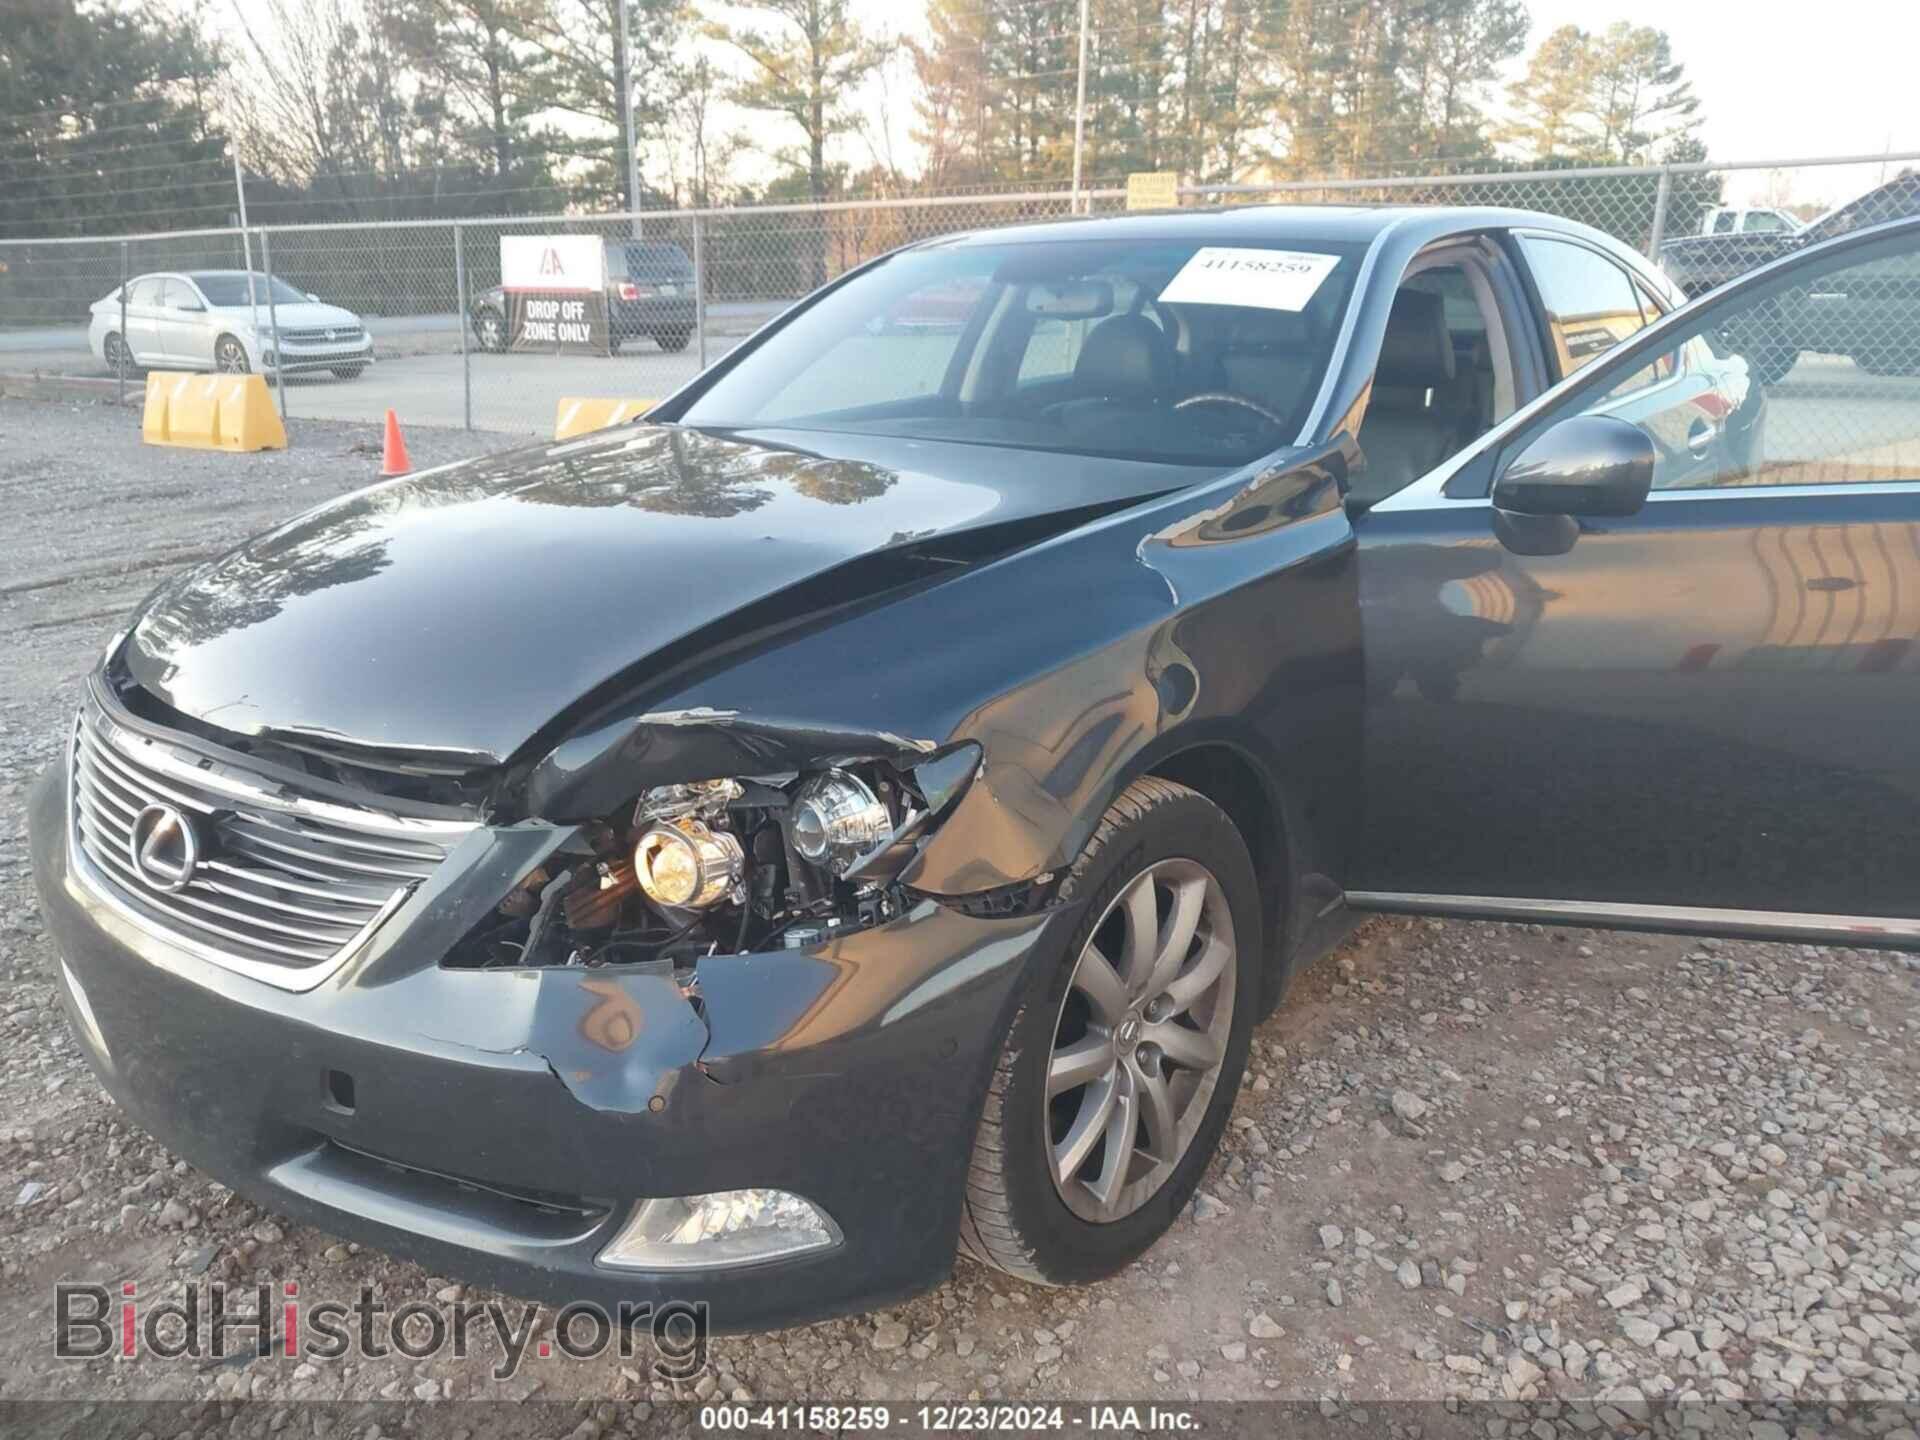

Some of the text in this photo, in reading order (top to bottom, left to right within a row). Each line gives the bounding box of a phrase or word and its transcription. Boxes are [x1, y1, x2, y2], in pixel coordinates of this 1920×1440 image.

[526, 300, 585, 321] DROP OFF
[523, 321, 591, 342] ZONE ONLY
